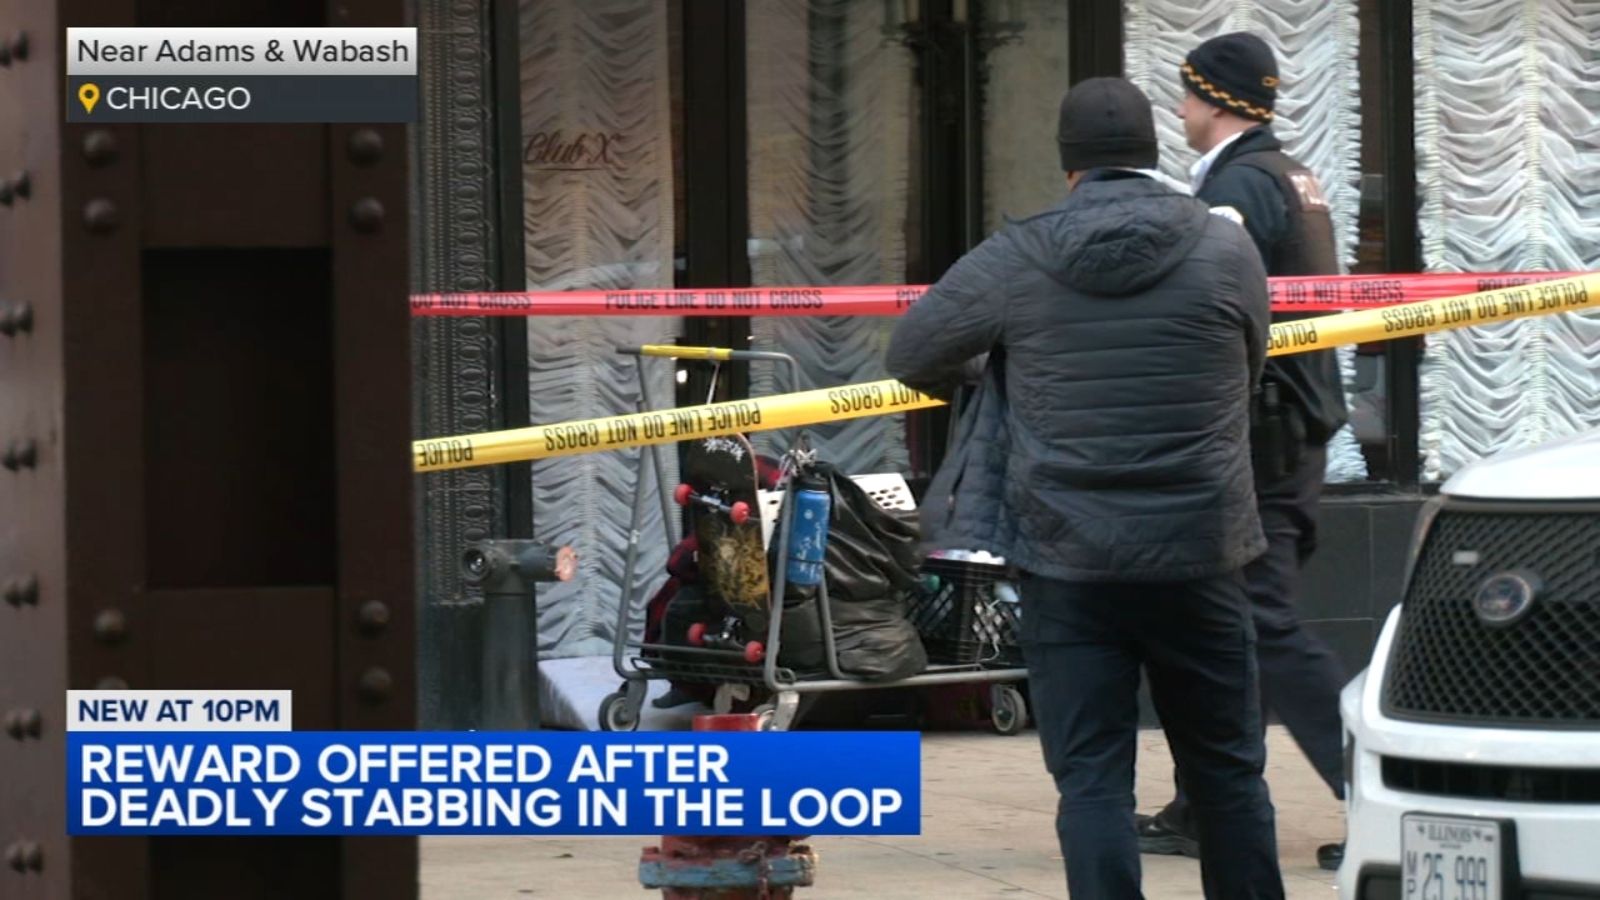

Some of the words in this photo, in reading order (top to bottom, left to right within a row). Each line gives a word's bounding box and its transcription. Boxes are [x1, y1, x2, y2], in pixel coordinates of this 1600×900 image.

[440, 293, 469, 309] NOT
[477, 292, 532, 310] CROSS
[605, 292, 661, 310] POLICE
[664, 291, 700, 310] LINE
[704, 291, 727, 309] DO
[732, 290, 762, 309] NOT
[769, 289, 824, 309] CROSS
[1285, 281, 1307, 304] DO
[1313, 281, 1343, 304] NOT
[1349, 280, 1404, 303] CROSS
[1499, 289, 1534, 315] LINE
[1535, 280, 1589, 310] POLICE
[1381, 303, 1436, 332] CROSS
[1441, 299, 1472, 325] NOT
[1475, 294, 1498, 318] DO
[828, 385, 884, 414] CROSS
[642, 414, 666, 439] DO
[666, 409, 704, 436] LINE
[705, 402, 762, 430] POLICE
[543, 422, 601, 451] CROSS
[605, 418, 638, 444] NOT
[418, 438, 474, 467] POLICE
[1428, 824, 1473, 842] ILLINOIS
